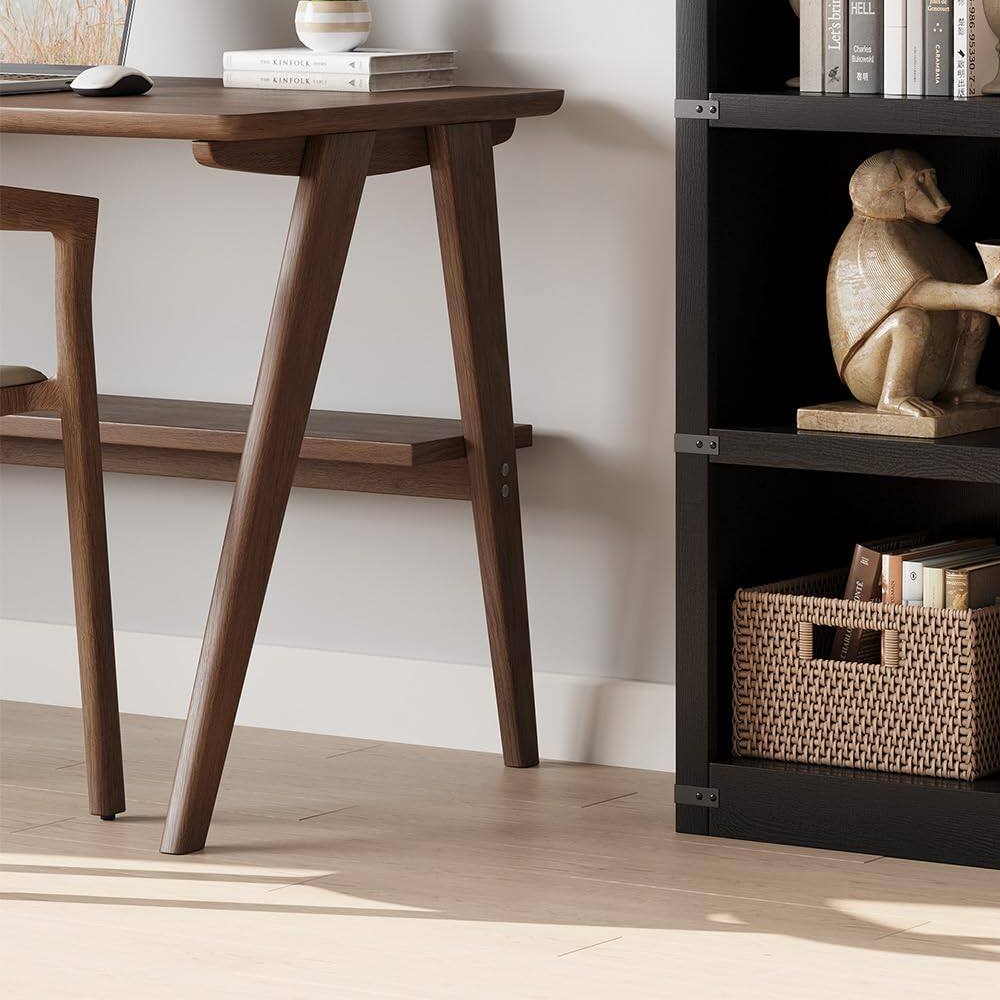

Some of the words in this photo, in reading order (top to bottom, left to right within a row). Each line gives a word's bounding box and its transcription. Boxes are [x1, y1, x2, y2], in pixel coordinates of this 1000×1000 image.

[850, 1, 876, 15] HELL
[827, 23, 841, 51] Let's
[853, 45, 872, 53] Charles
[851, 55, 875, 63] Bukowski
